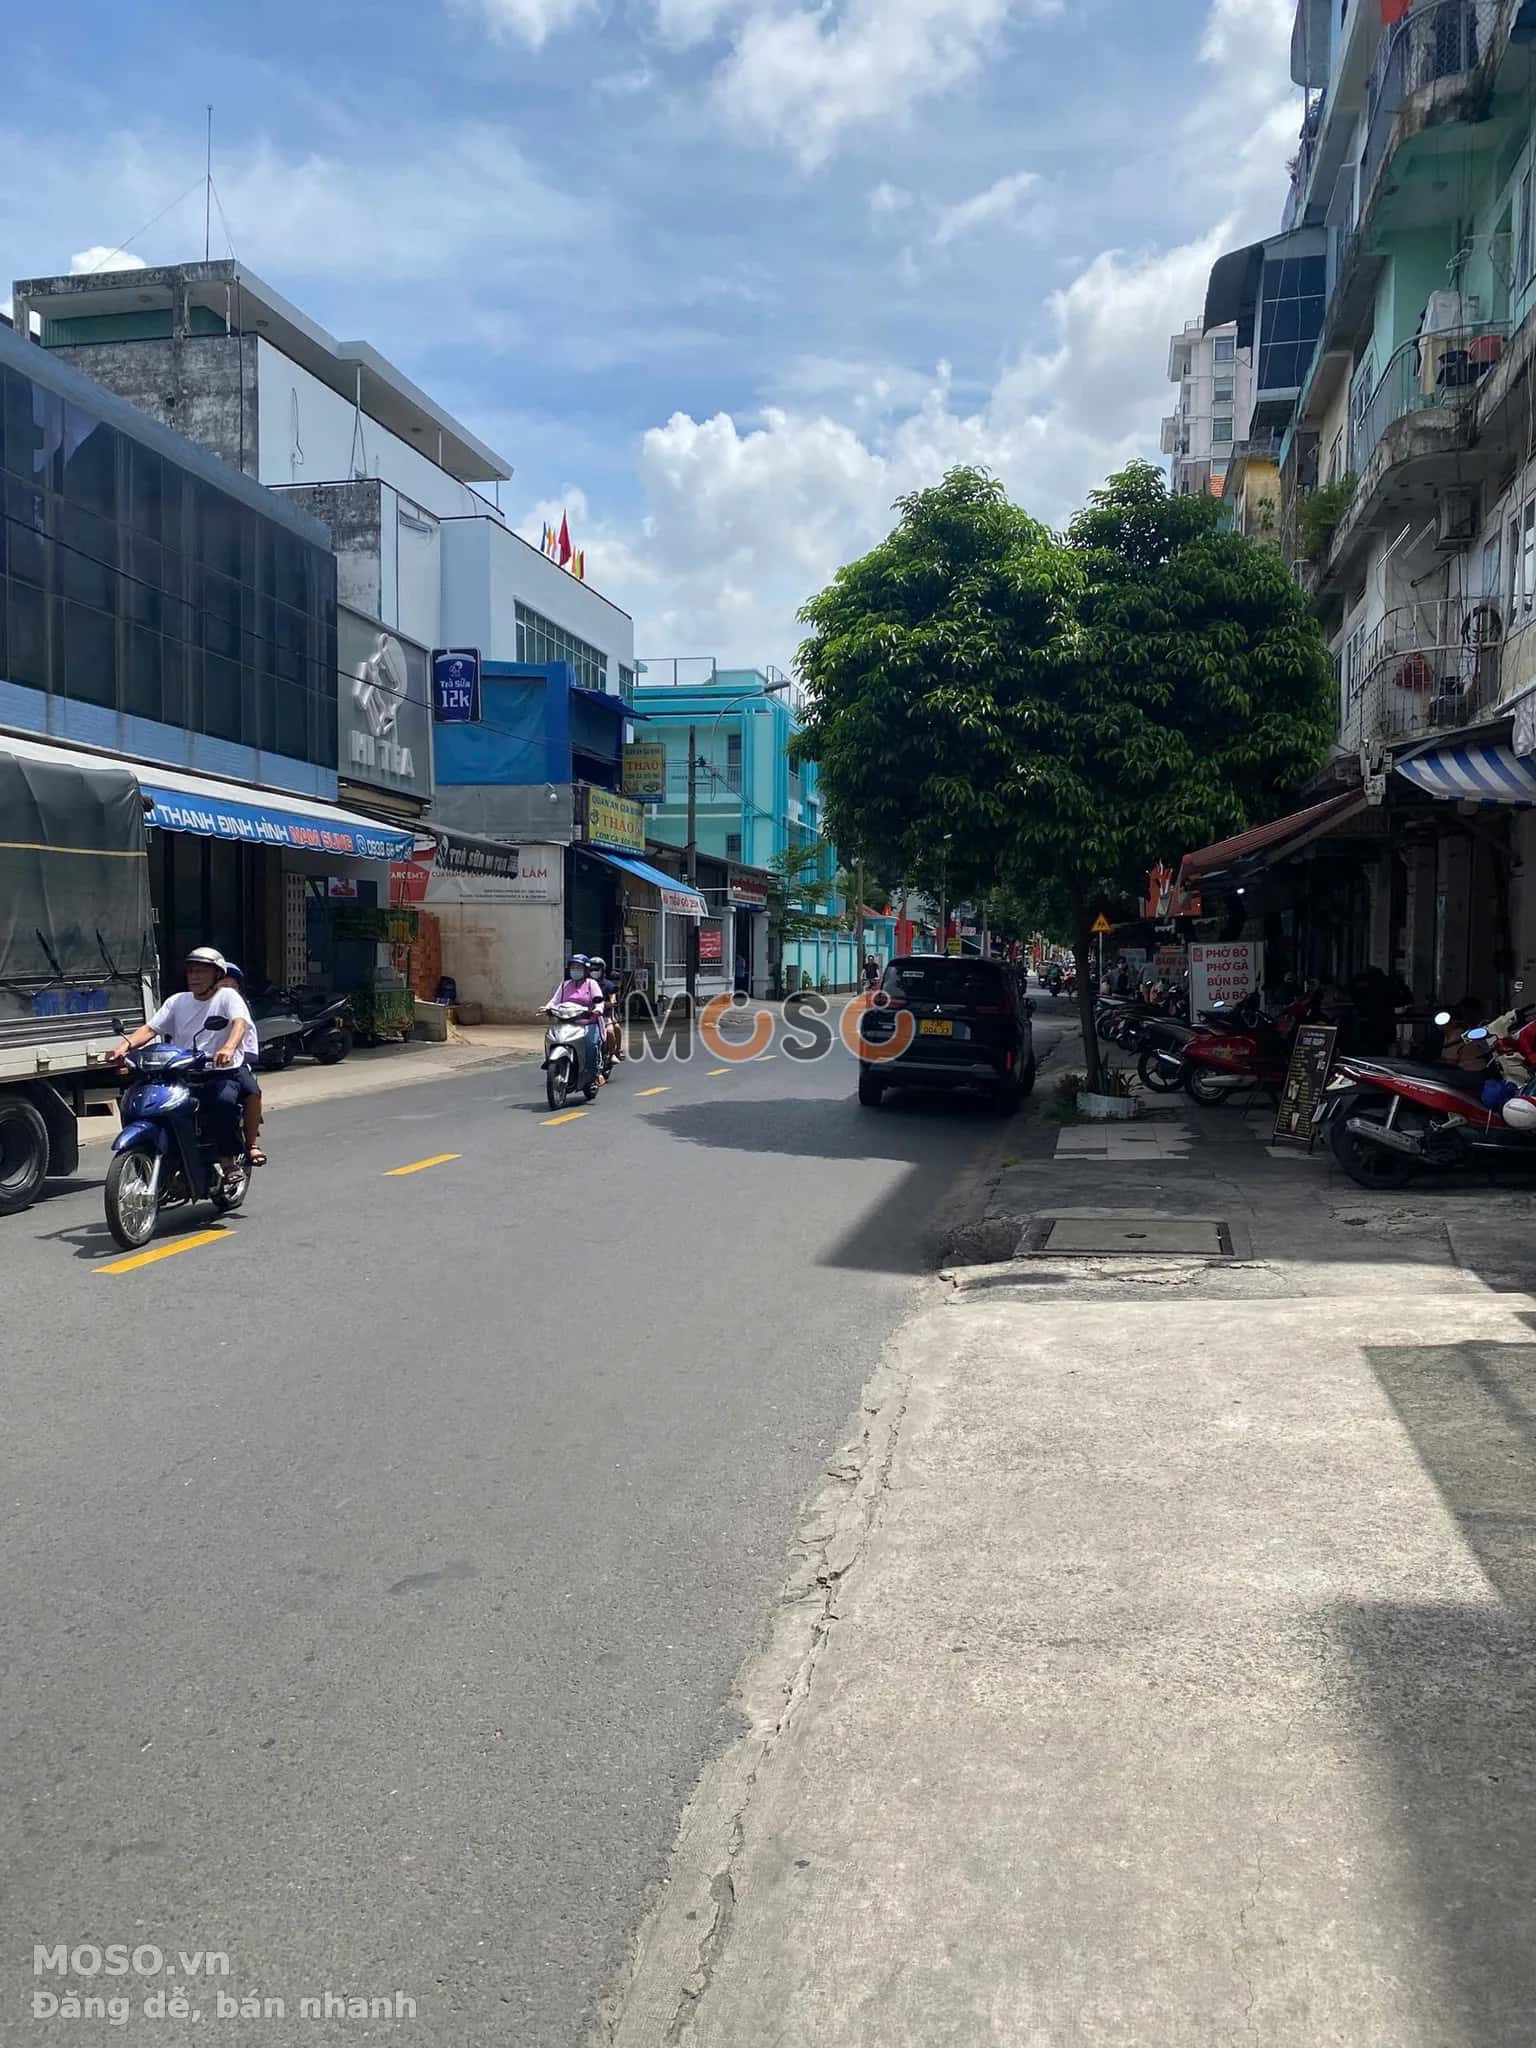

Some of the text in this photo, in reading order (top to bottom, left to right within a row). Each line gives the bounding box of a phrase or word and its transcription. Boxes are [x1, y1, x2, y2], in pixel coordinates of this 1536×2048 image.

[441, 689, 470, 708] 12k
[376, 739, 416, 778] TEA
[156, 804, 217, 831] THANH
[255, 815, 290, 842] HÌNH
[1206, 945, 1248, 958] PHỞ BÒ
[1206, 959, 1249, 972] PHỞ GÀ
[1207, 973, 1249, 986] BÚN BÒ
[1232, 988, 1249, 1000] BÒ
